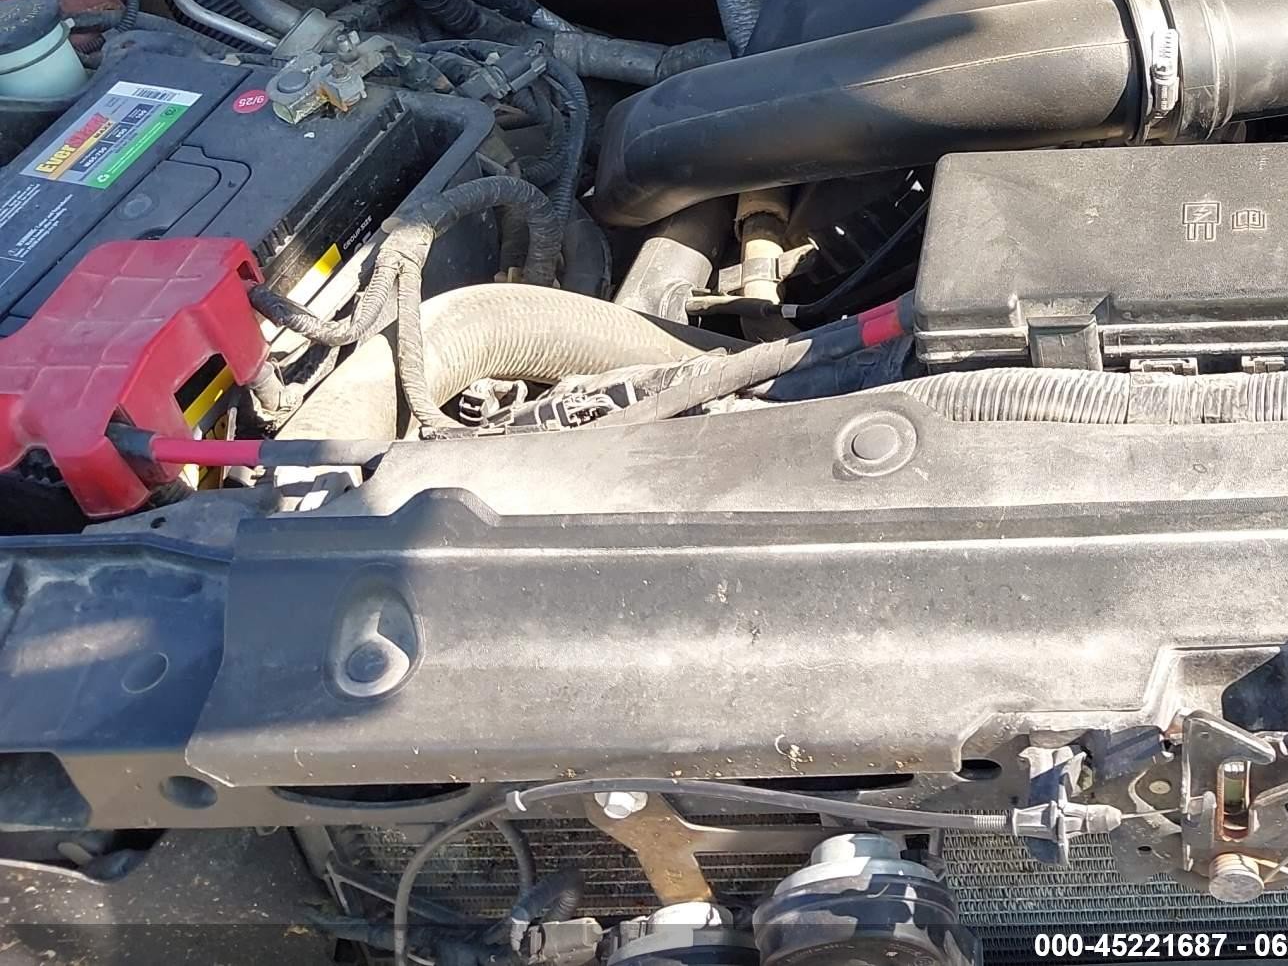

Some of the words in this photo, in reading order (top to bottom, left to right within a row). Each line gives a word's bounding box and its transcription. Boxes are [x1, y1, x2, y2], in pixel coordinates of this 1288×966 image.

[237, 94, 266, 108] 9/25
[343, 227, 361, 250] GROUP
[360, 214, 373, 232] SIZE
